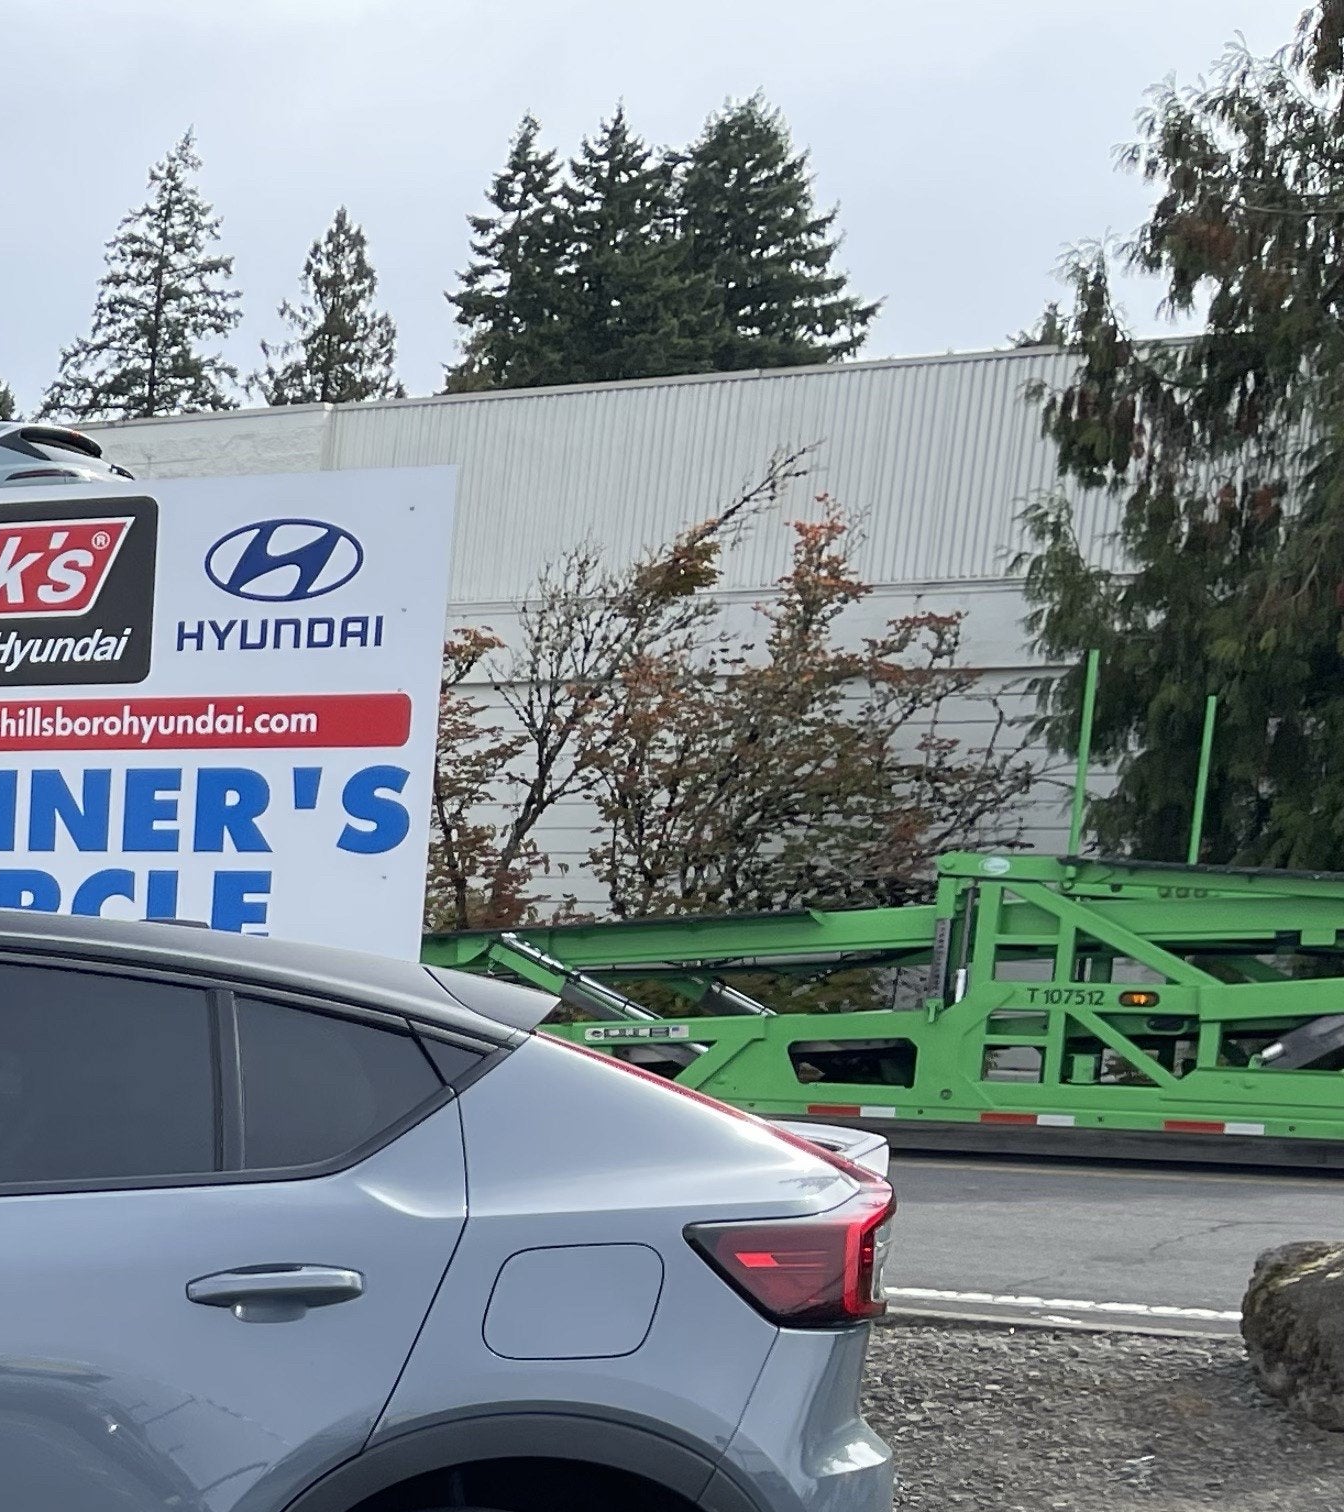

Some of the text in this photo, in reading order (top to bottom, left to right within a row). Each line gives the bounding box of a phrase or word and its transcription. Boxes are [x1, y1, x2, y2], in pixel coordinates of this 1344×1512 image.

[177, 615, 383, 652] HYUNDAI
[1027, 987, 1104, 1006] T 107512
